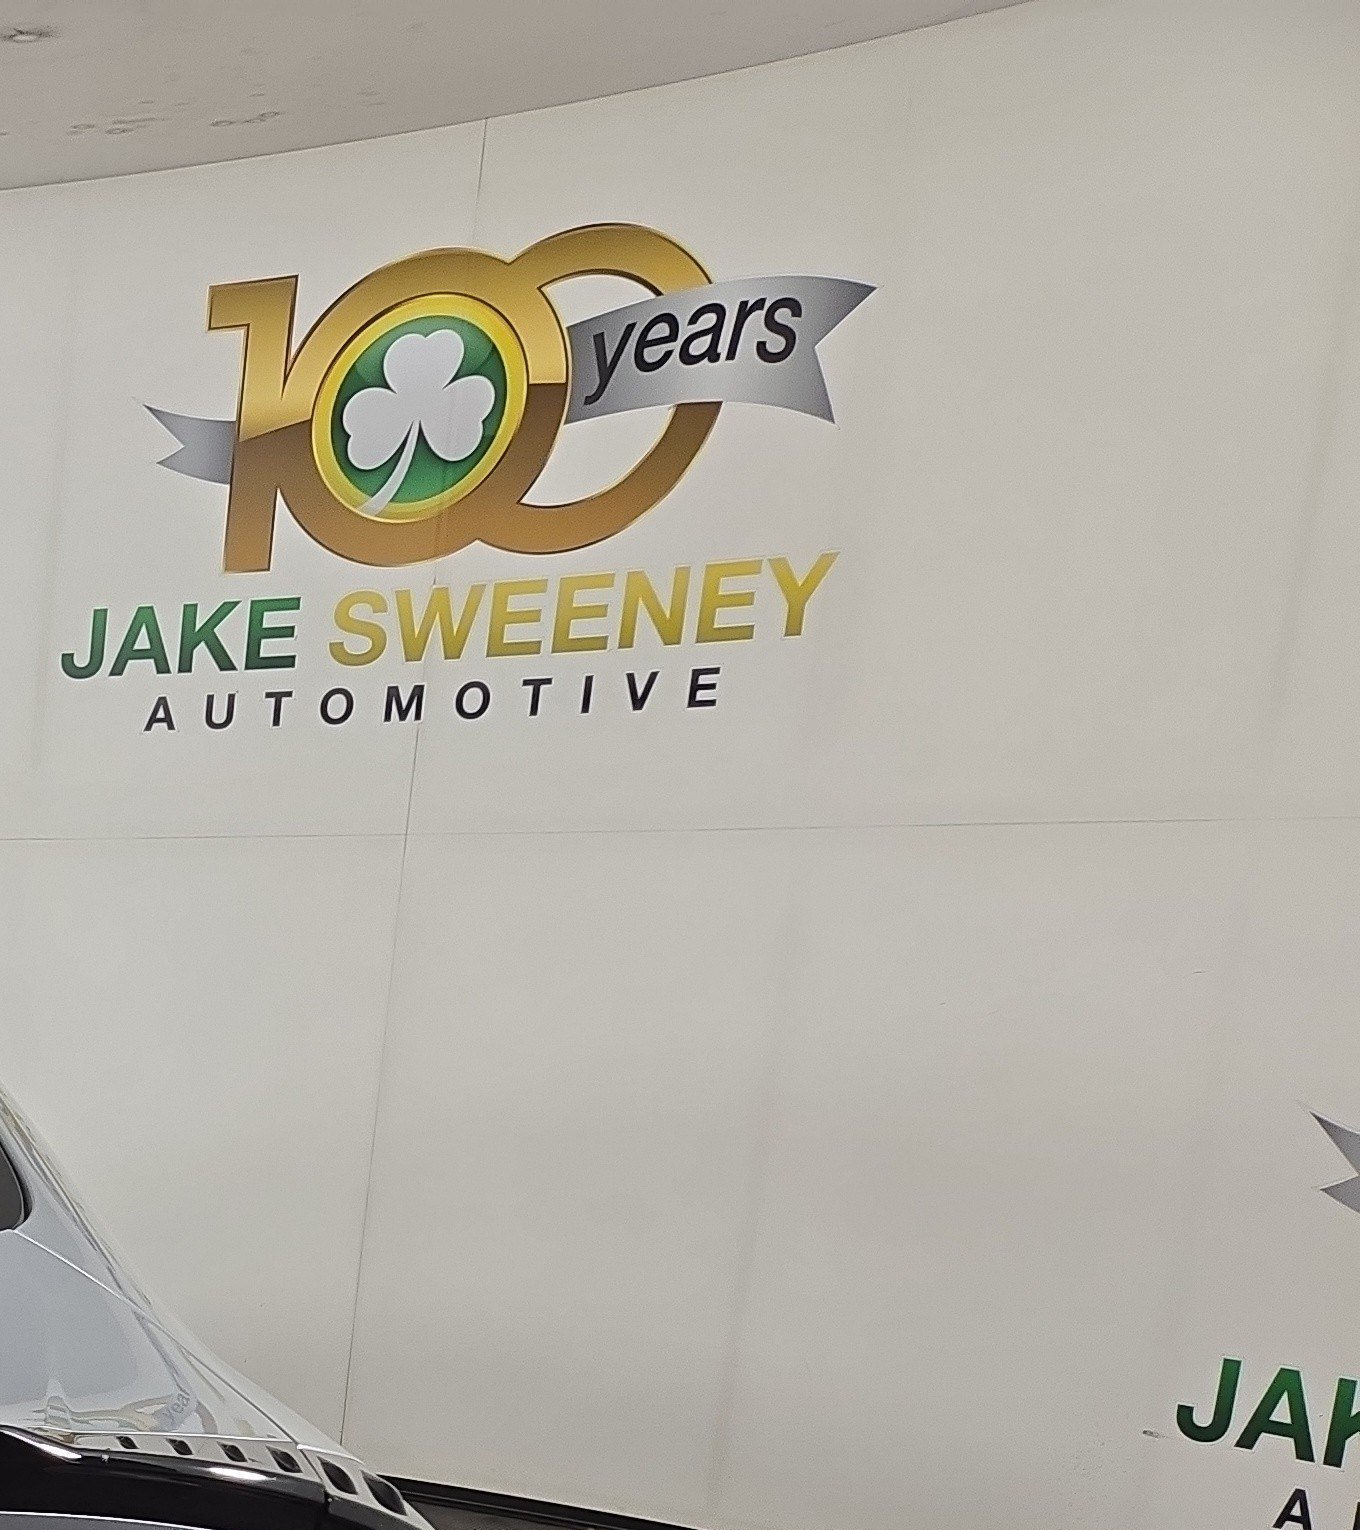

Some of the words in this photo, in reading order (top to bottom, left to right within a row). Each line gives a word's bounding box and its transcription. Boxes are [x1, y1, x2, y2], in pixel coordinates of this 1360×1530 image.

[584, 295, 803, 406] years
[60, 595, 302, 682] JAKE
[328, 552, 842, 668] SWEENEY
[143, 666, 722, 732] AUTOMOTIVE
